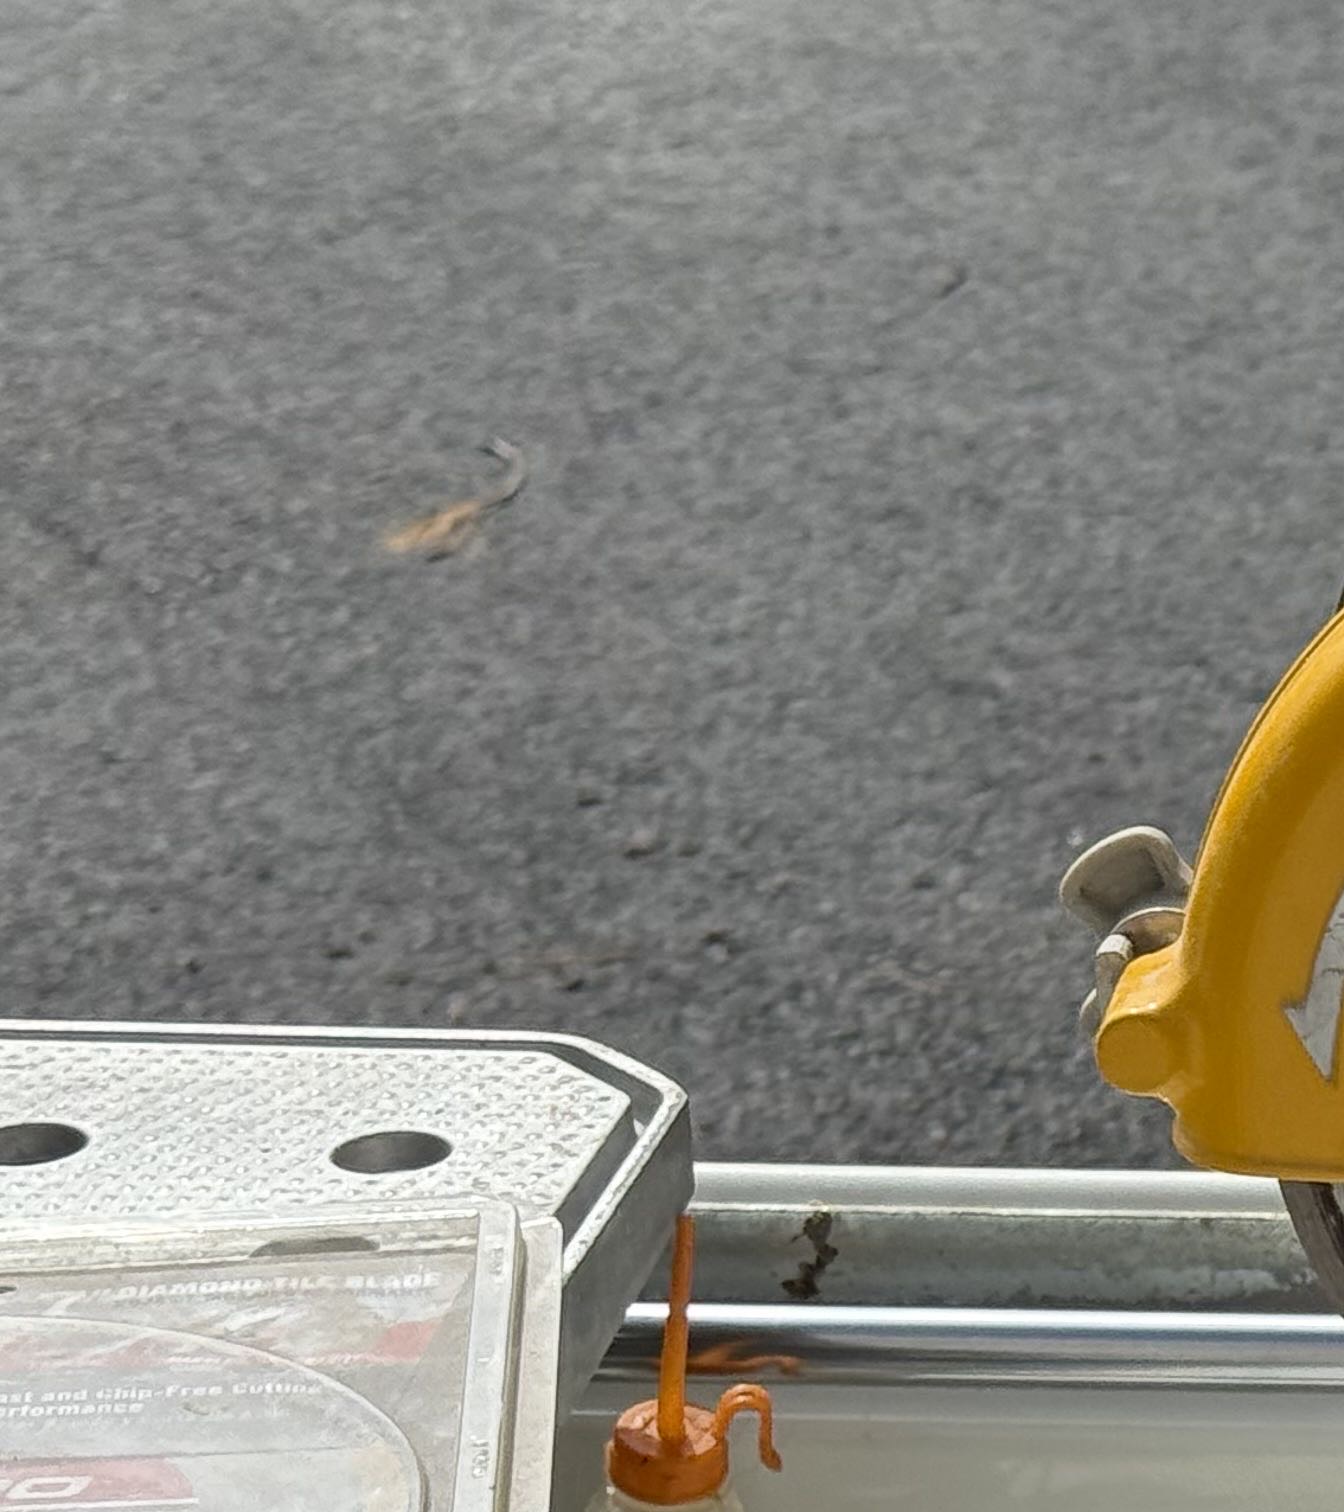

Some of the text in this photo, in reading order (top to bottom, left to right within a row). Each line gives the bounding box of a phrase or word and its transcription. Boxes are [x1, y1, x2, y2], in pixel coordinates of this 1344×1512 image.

[113, 1277, 262, 1302] DIAMOND
[344, 1269, 443, 1291] BLADE
[40, 1387, 88, 1402] and
